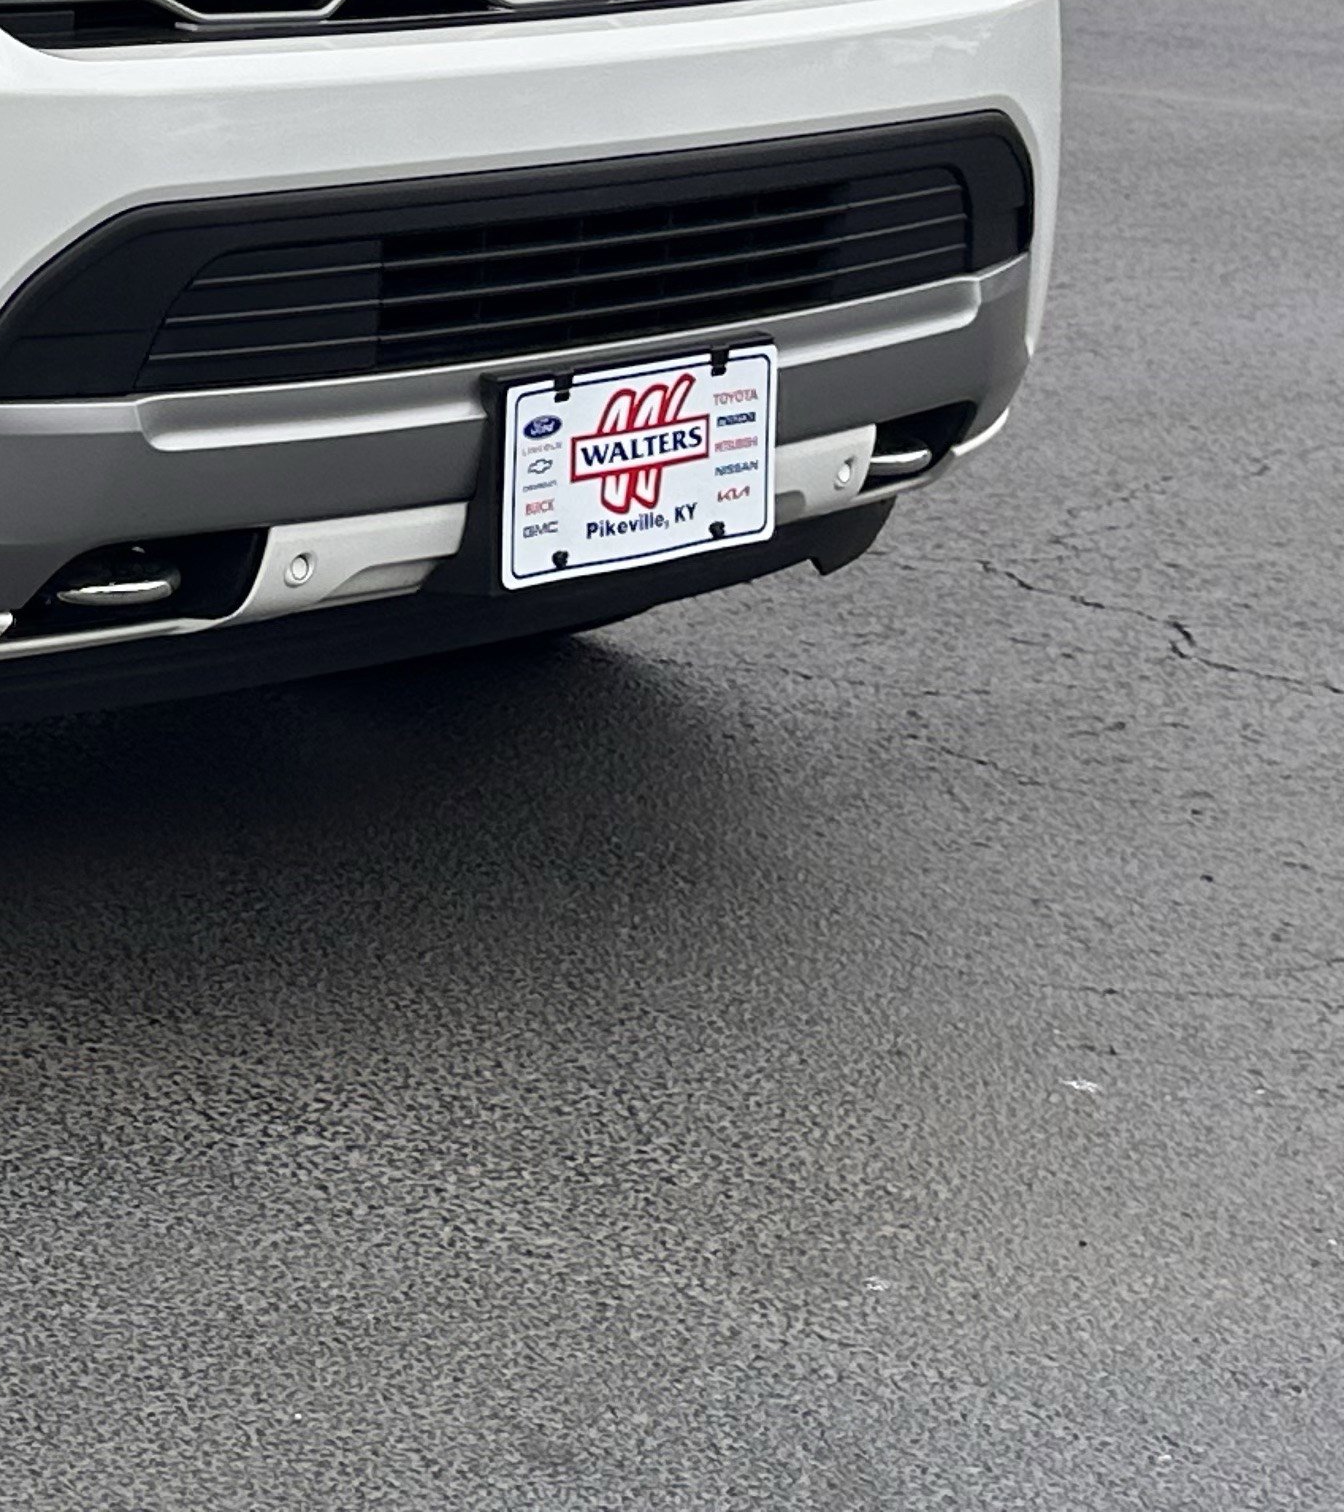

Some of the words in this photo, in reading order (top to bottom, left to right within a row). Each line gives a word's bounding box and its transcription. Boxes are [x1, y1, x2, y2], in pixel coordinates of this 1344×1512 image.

[713, 388, 759, 405] TOYOTA
[581, 425, 703, 467] WALTERS
[585, 511, 670, 539] Pikeville,
[674, 501, 699, 523] KY
